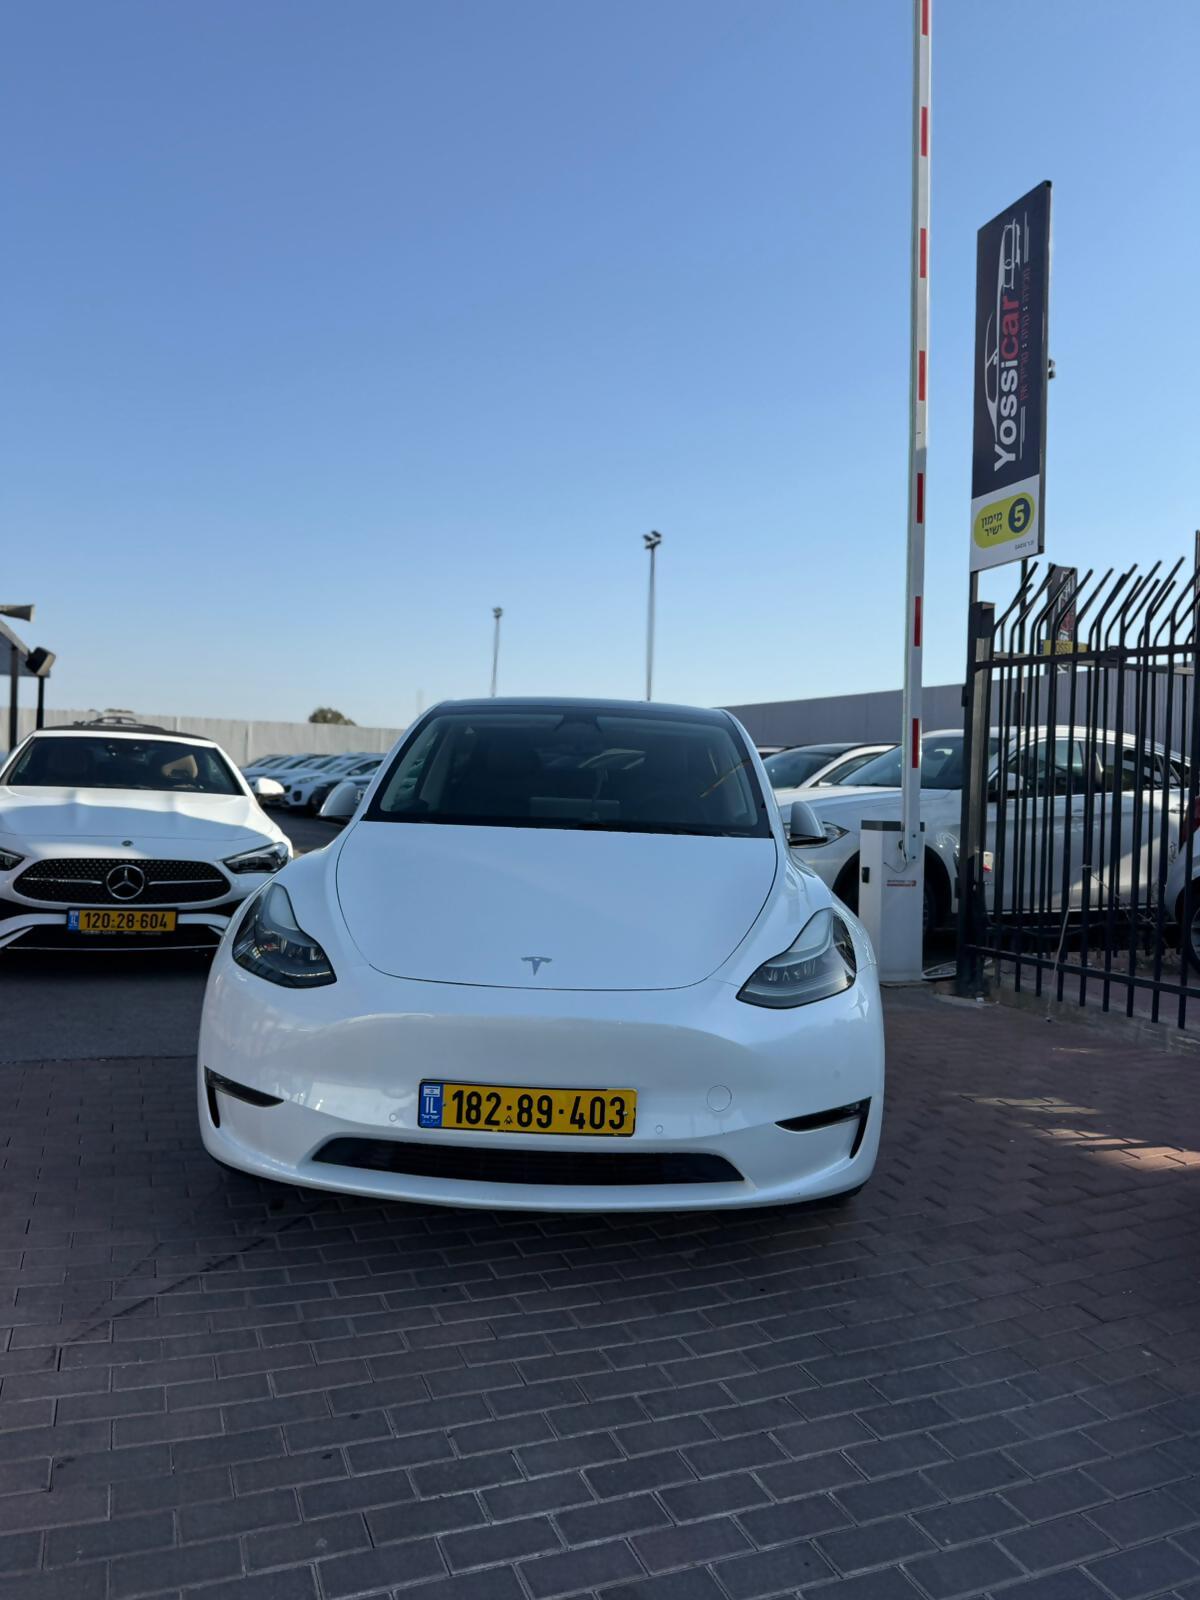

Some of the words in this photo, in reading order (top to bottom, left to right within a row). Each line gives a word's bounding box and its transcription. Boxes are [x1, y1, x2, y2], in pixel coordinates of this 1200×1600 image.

[981, 511, 1003, 529] מימון
[1014, 504, 1025, 528] 5
[985, 523, 1003, 537] ישיר
[425, 1096, 438, 1114] IL
